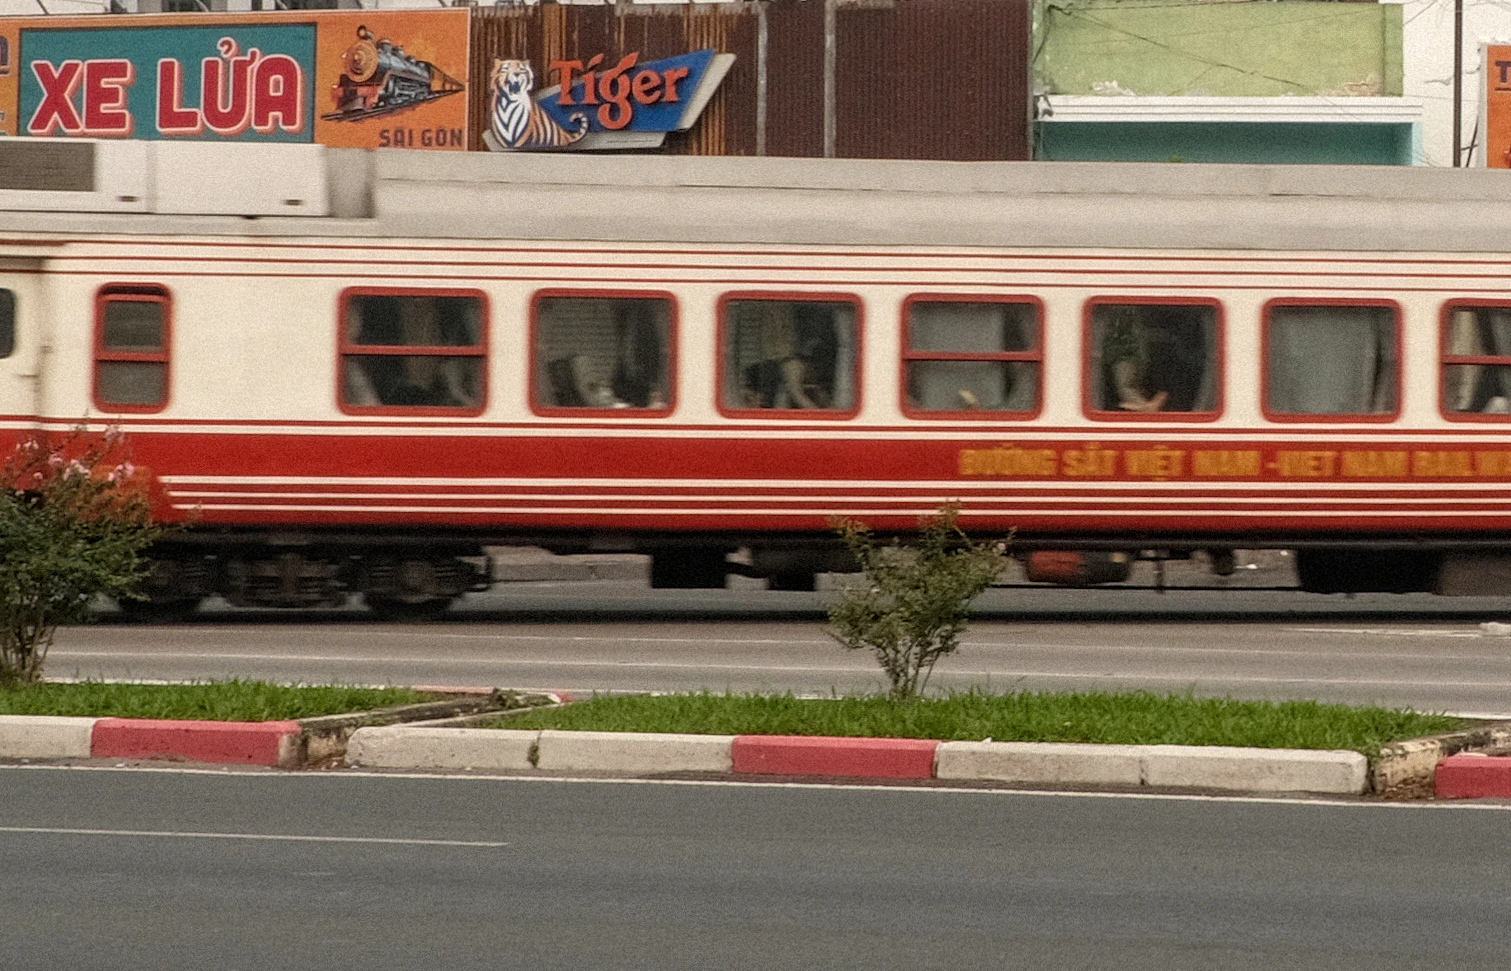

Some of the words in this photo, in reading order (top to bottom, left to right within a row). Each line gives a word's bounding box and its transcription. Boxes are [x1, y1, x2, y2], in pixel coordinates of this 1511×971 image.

[28, 59, 135, 134] XE
[157, 37, 306, 134] LỬA
[549, 51, 689, 130] Tiger
[1192, 450, 1261, 476] NAM
[1340, 450, 1409, 477] NAM
